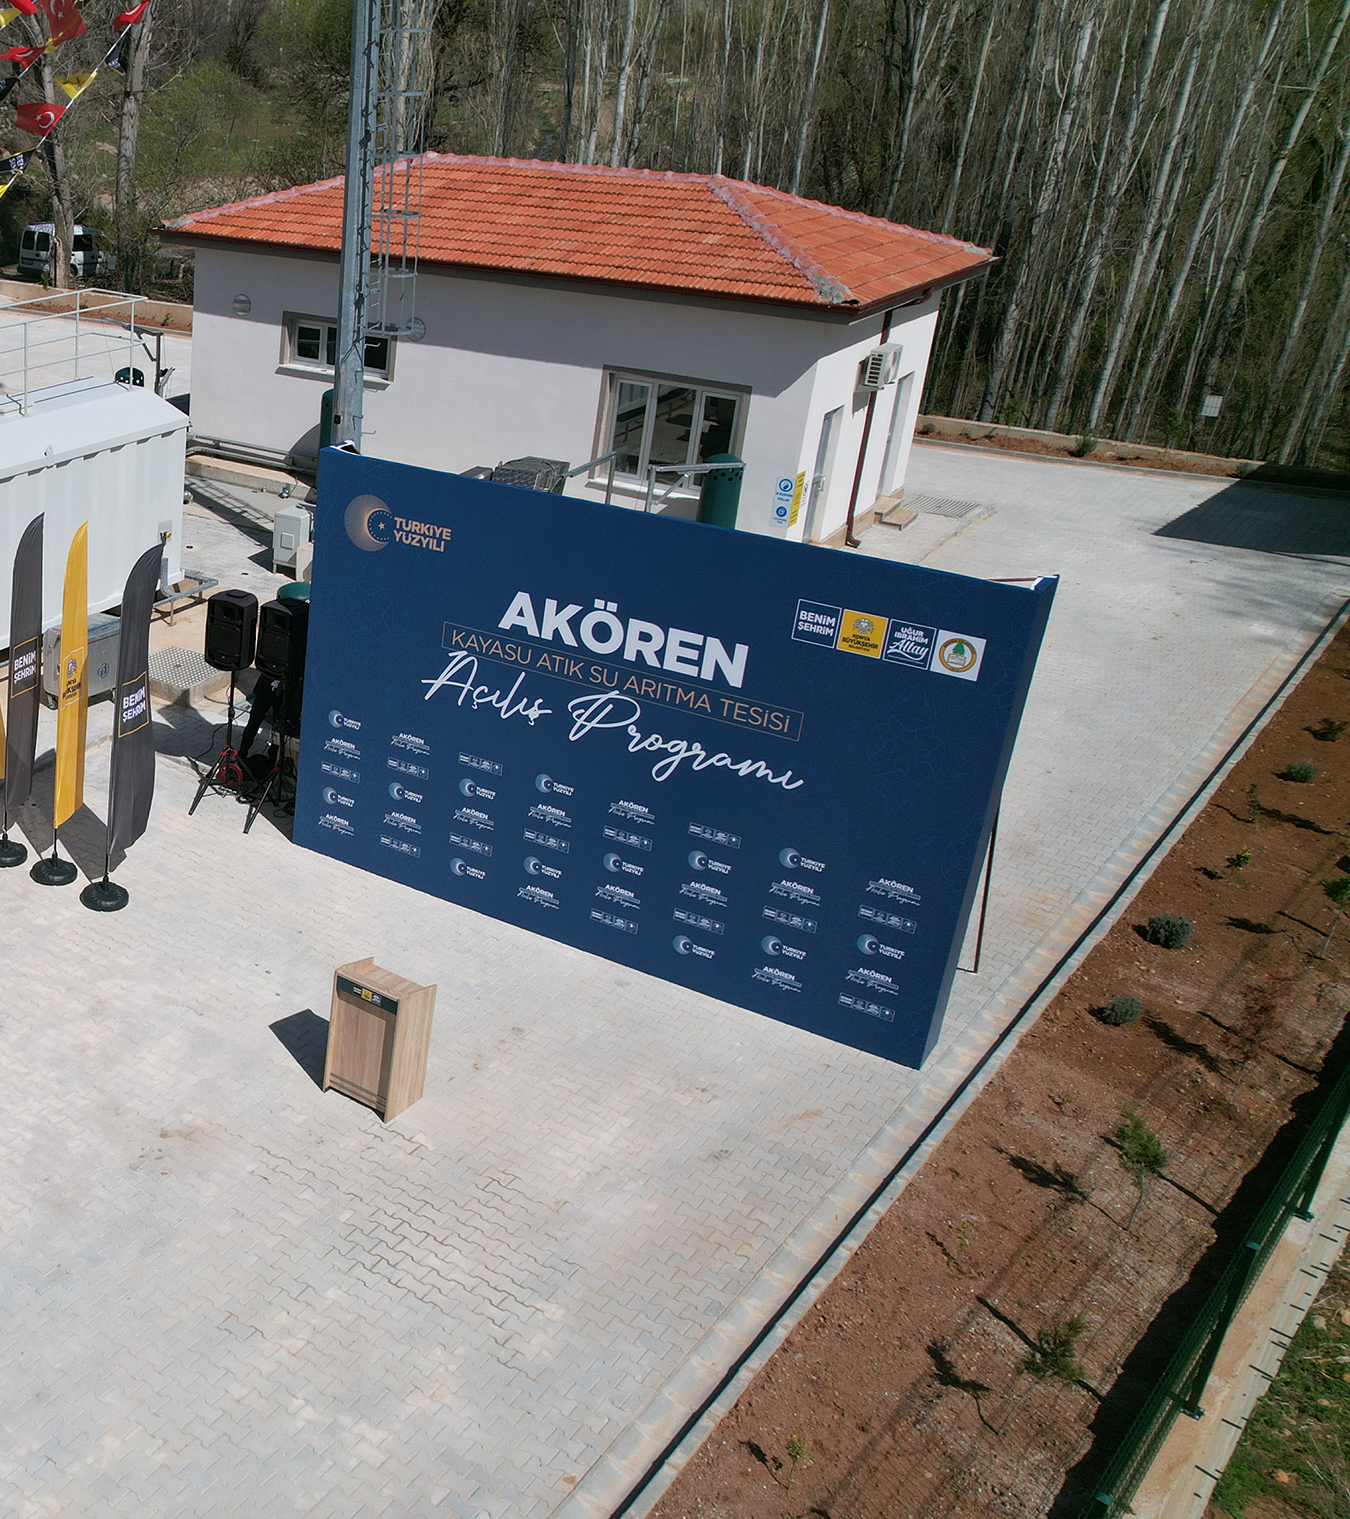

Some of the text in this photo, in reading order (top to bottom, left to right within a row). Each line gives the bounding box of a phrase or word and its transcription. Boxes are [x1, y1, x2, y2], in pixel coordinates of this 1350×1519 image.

[800, 610, 836, 627] BENİM
[798, 622, 834, 637] ŞEHRİM
[901, 626, 924, 637] UĞUR
[498, 590, 749, 688] AKÖREN
[452, 630, 791, 733] KAYASU ATIK SU ARITMA TESİSİ
[421, 650, 804, 790] Açılış Programı
[781, 880, 813, 893] AKÖREN
[879, 878, 913, 893] AKÖREN
[763, 966, 795, 980] AKÖREN
[858, 968, 892, 983] AKÖREN
